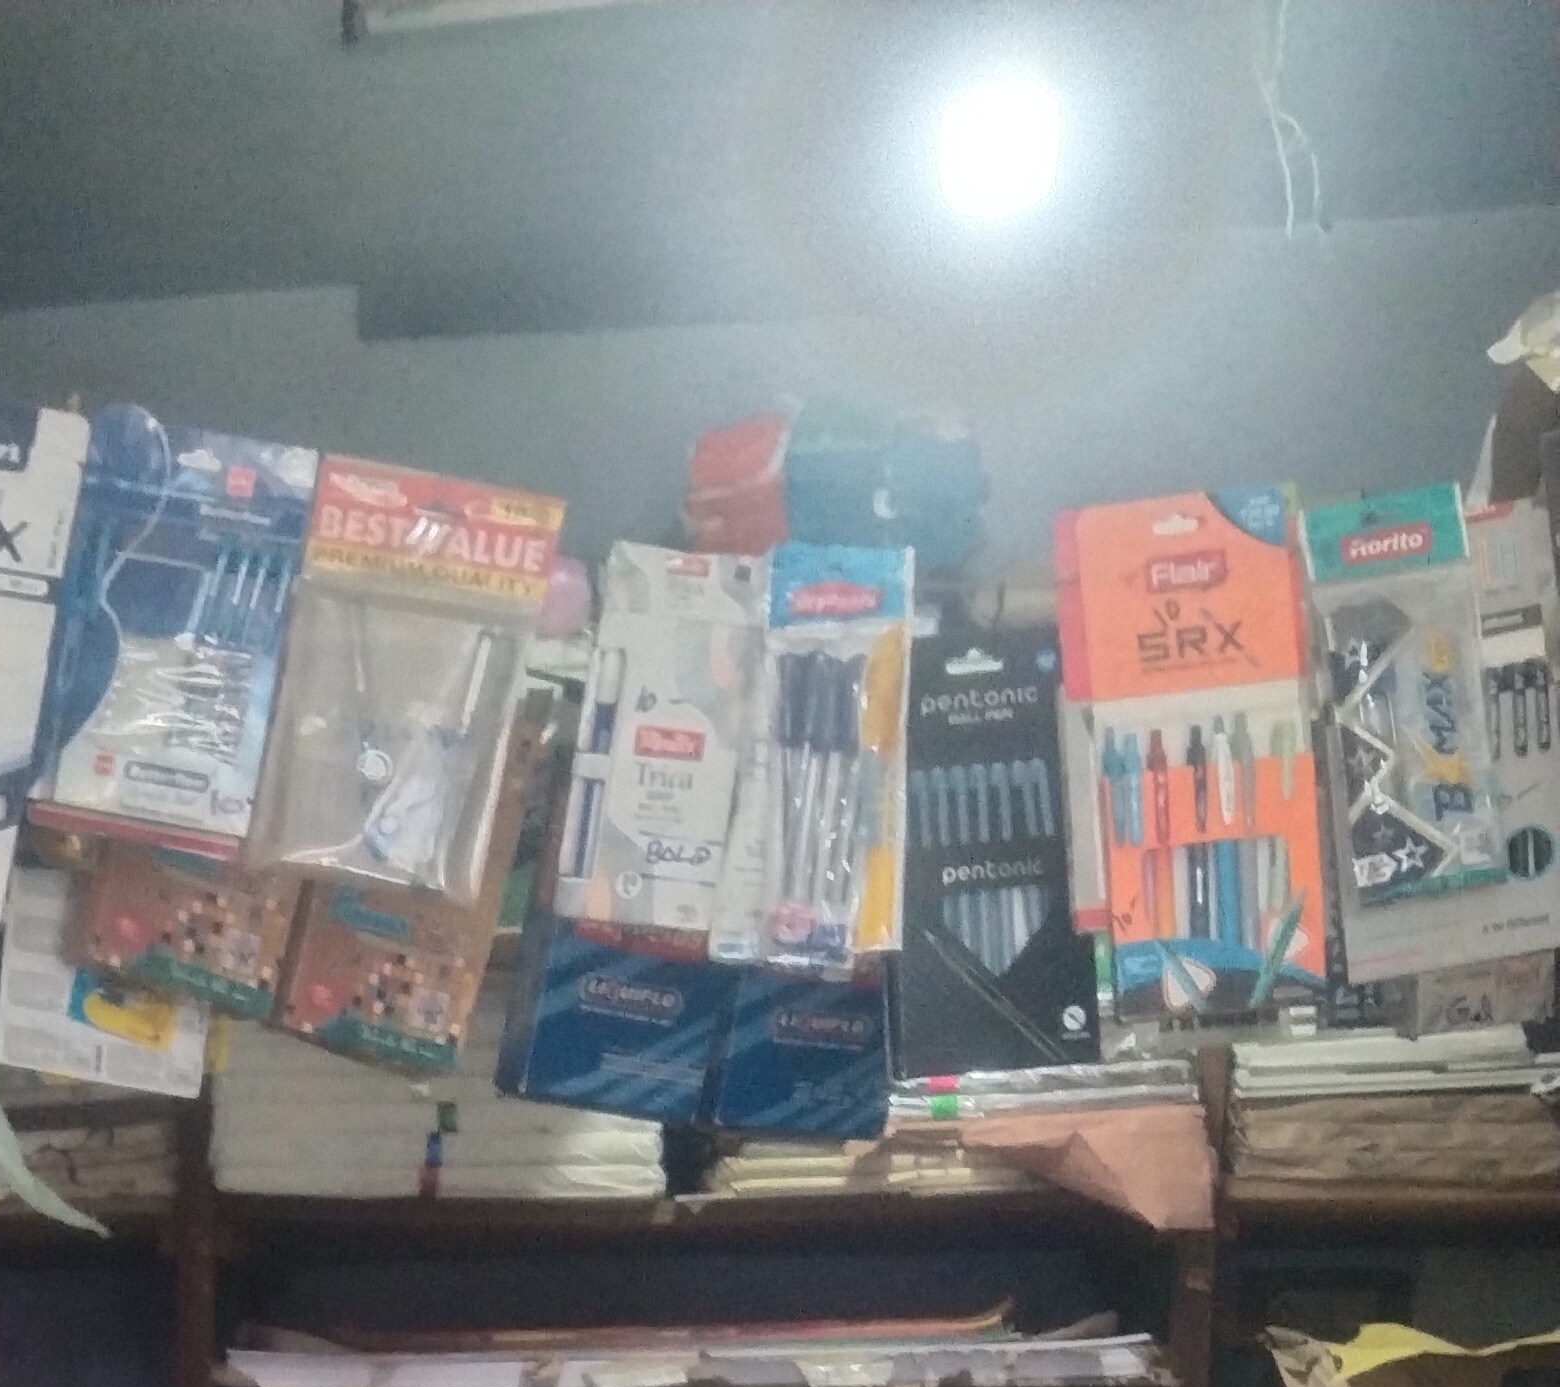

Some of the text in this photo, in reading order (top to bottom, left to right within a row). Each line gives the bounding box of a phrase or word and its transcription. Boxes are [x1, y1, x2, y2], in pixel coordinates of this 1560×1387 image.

[319, 503, 413, 548] BEST
[1137, 605, 1262, 668] SRX
[920, 685, 1038, 717] pentonic
[941, 855, 1043, 886] pentonic
